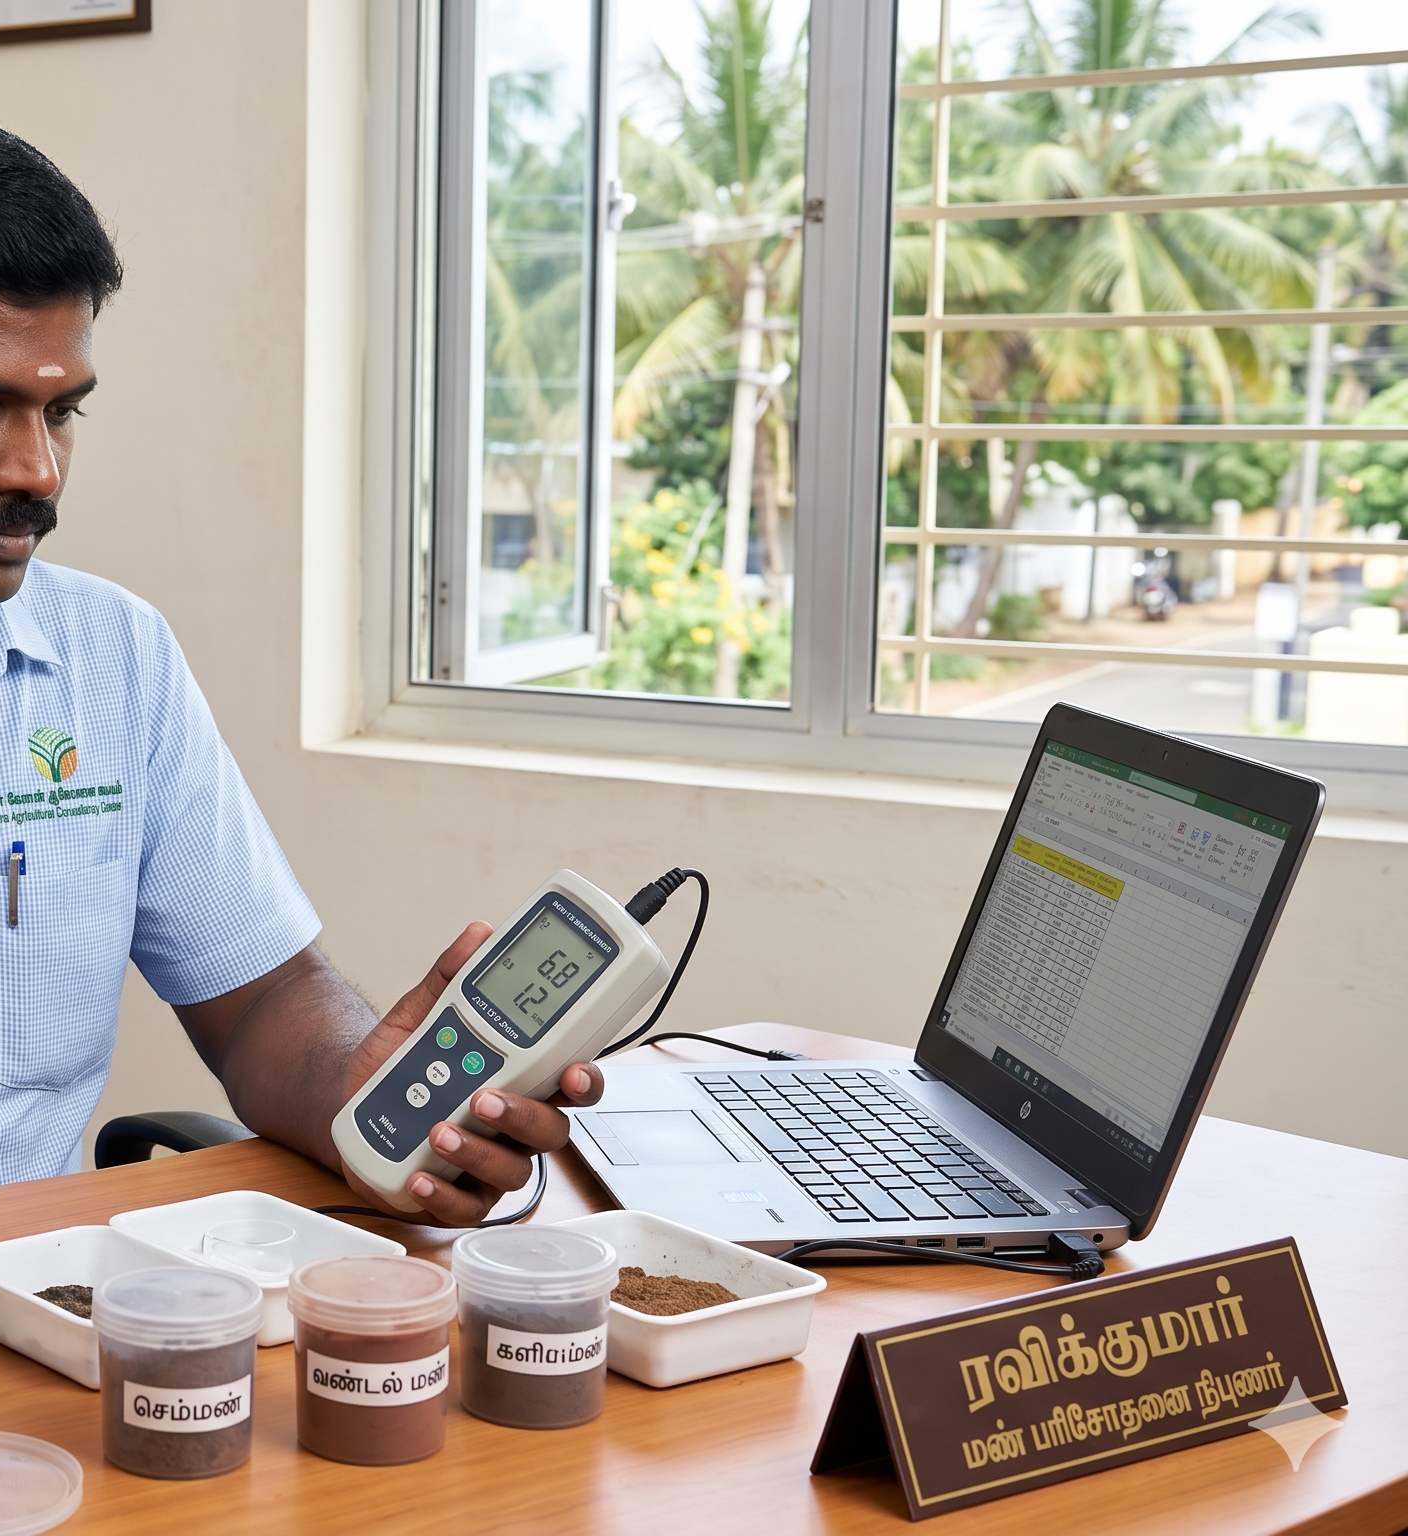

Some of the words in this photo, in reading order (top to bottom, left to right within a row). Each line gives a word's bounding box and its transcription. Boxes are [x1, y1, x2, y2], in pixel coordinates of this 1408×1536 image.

[536, 949, 580, 989] 6.8
[512, 982, 549, 1015] 1.2
[958, 1274, 1250, 1413] ரவிக்குமார்
[312, 1368, 403, 1395] வண்டல்
[410, 1360, 446, 1392] மண்
[133, 1391, 243, 1422] செம்மண்
[962, 1418, 1027, 1470] மண்
[1030, 1381, 1193, 1441] பரிசோதனை
[1193, 1350, 1286, 1420] நிபுணர்
